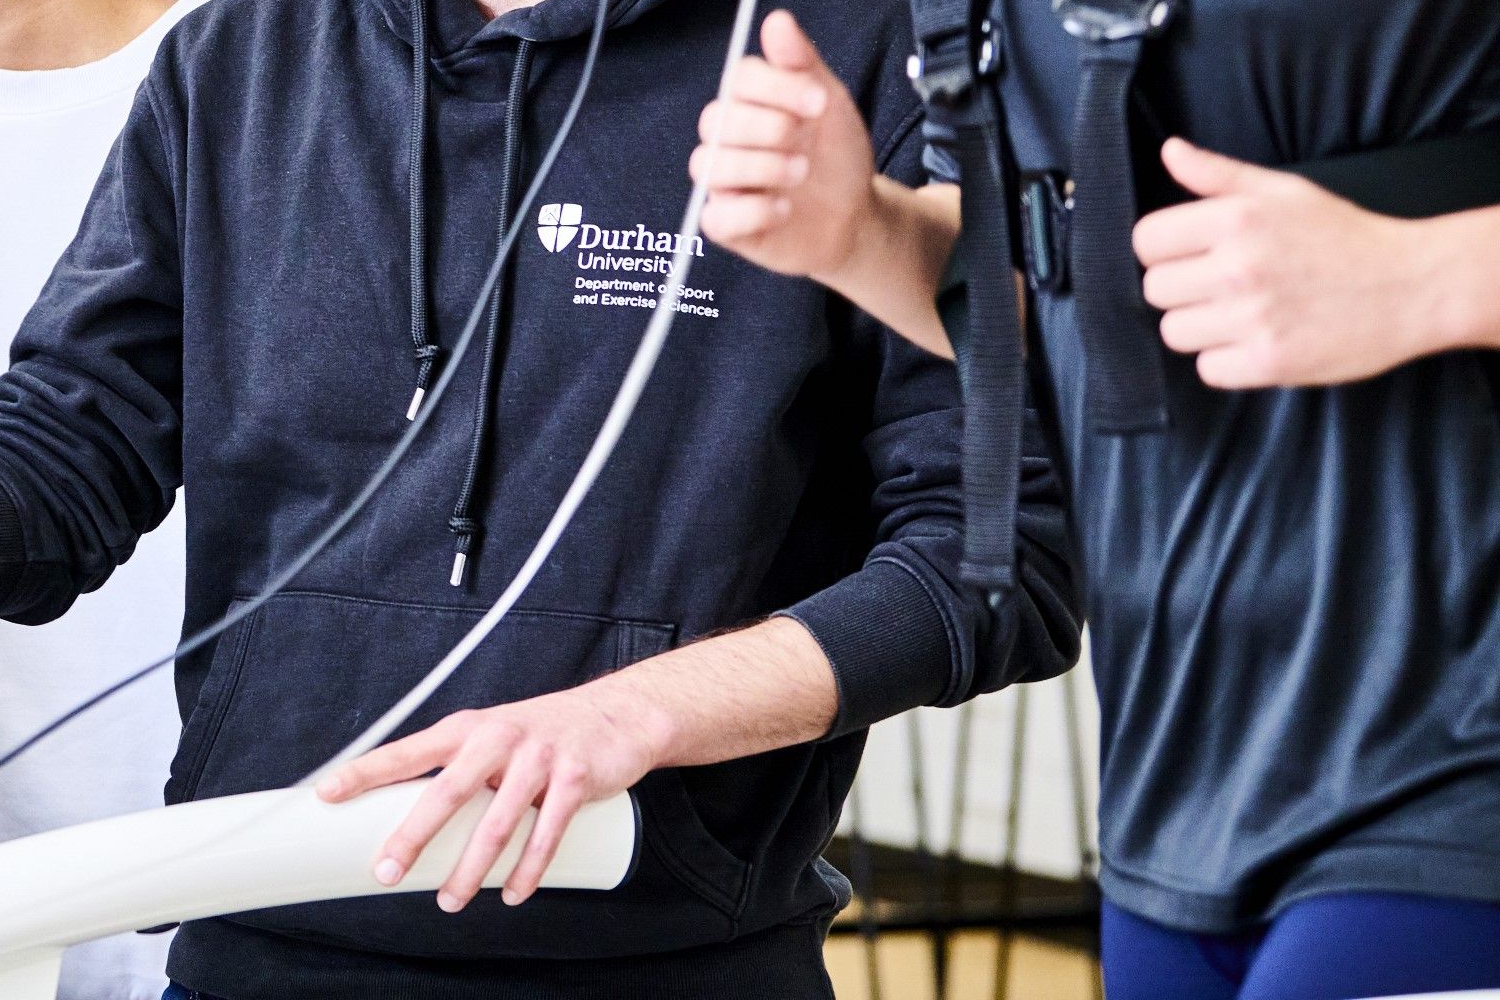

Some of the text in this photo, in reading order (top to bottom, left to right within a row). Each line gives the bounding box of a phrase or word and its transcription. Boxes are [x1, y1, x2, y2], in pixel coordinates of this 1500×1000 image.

[577, 223, 705, 257] Durham
[573, 293, 599, 305] and
[601, 293, 657, 309] Exercise
[575, 276, 655, 292] Department
[676, 284, 715, 302] Sport
